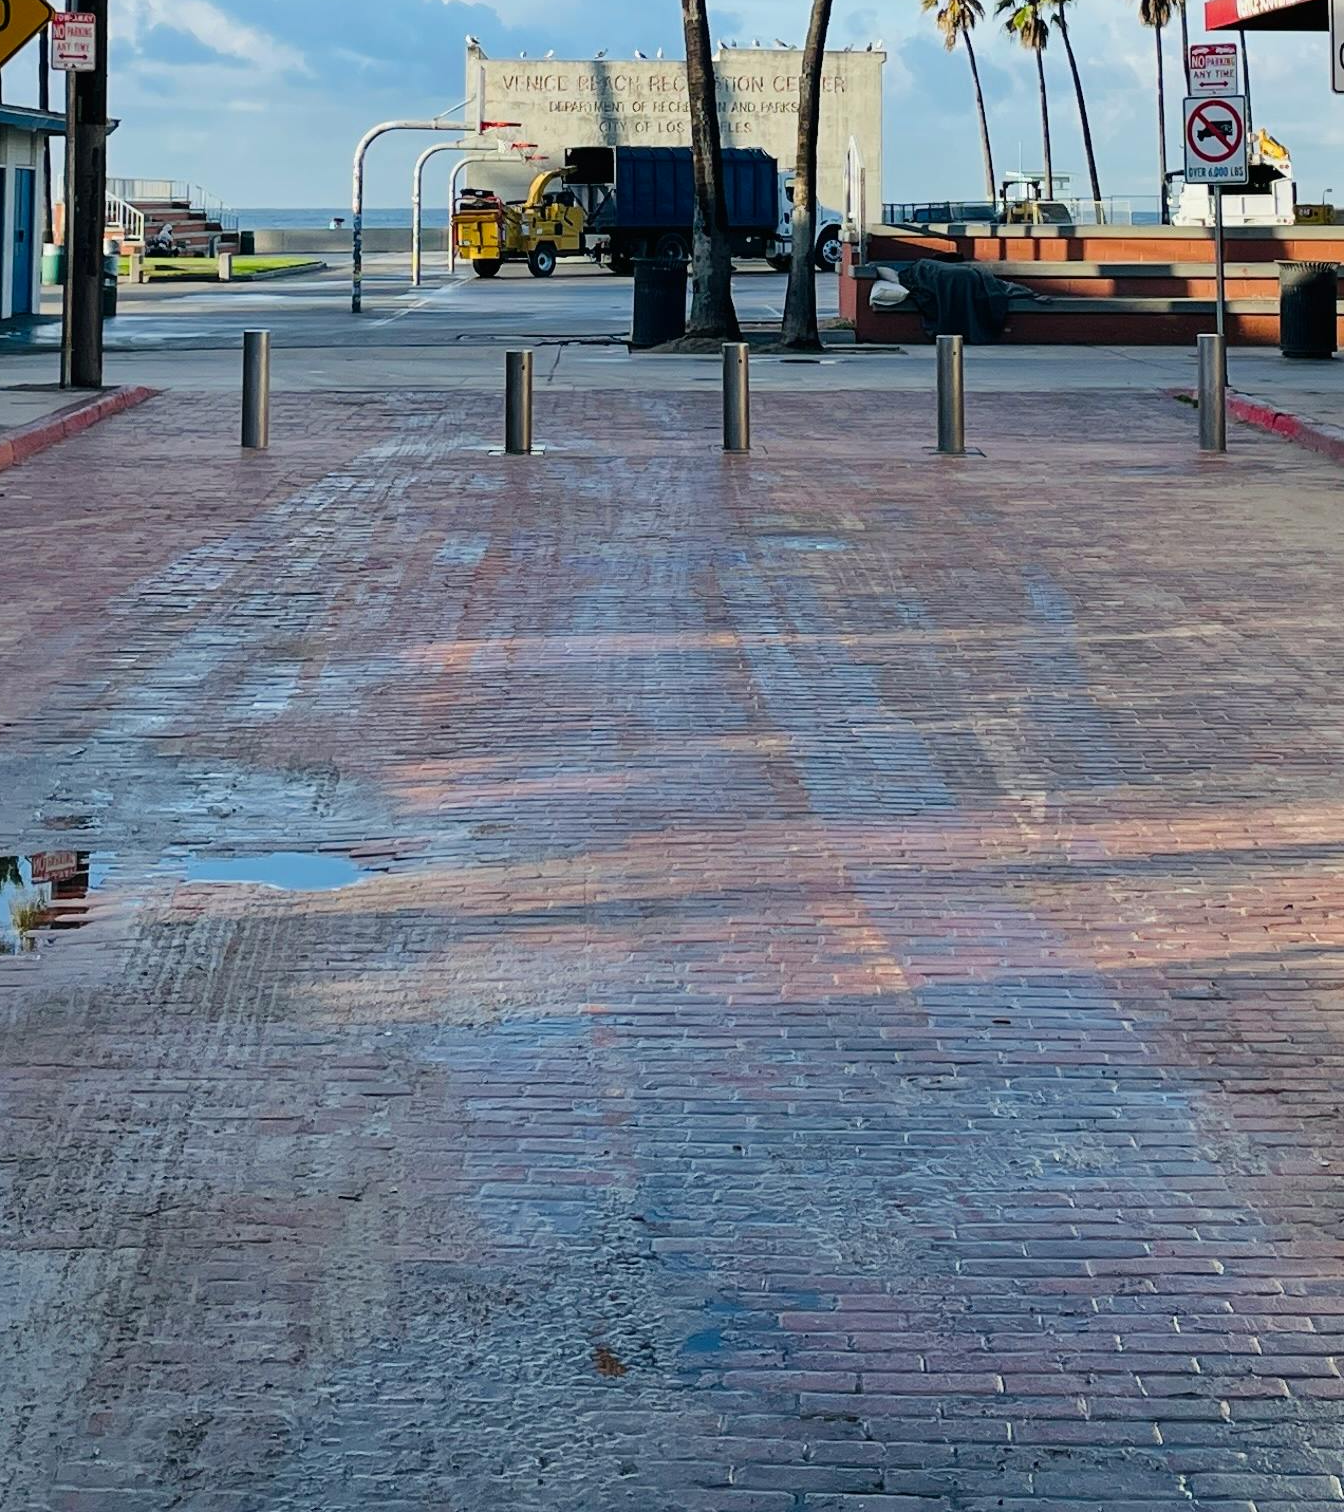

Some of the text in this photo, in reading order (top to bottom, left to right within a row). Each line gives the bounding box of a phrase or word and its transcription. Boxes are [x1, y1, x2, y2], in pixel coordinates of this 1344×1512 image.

[57, 42, 71, 52] ANY
[1191, 55, 1235, 68] NO PARKING
[1193, 69, 1234, 79] ANY TIME
[502, 74, 568, 92] VENICE
[578, 74, 640, 92] BEACH
[773, 75, 846, 93] CEER
[549, 100, 625, 113] DEPARTMENT
[632, 101, 647, 113] OF
[731, 101, 756, 113] AND
[760, 101, 800, 114] PARKS
[599, 120, 627, 133] CITY
[635, 121, 650, 133] OF
[658, 121, 686, 133] LOS
[1188, 167, 1207, 178] OVER
[1230, 166, 1244, 178] LBS
